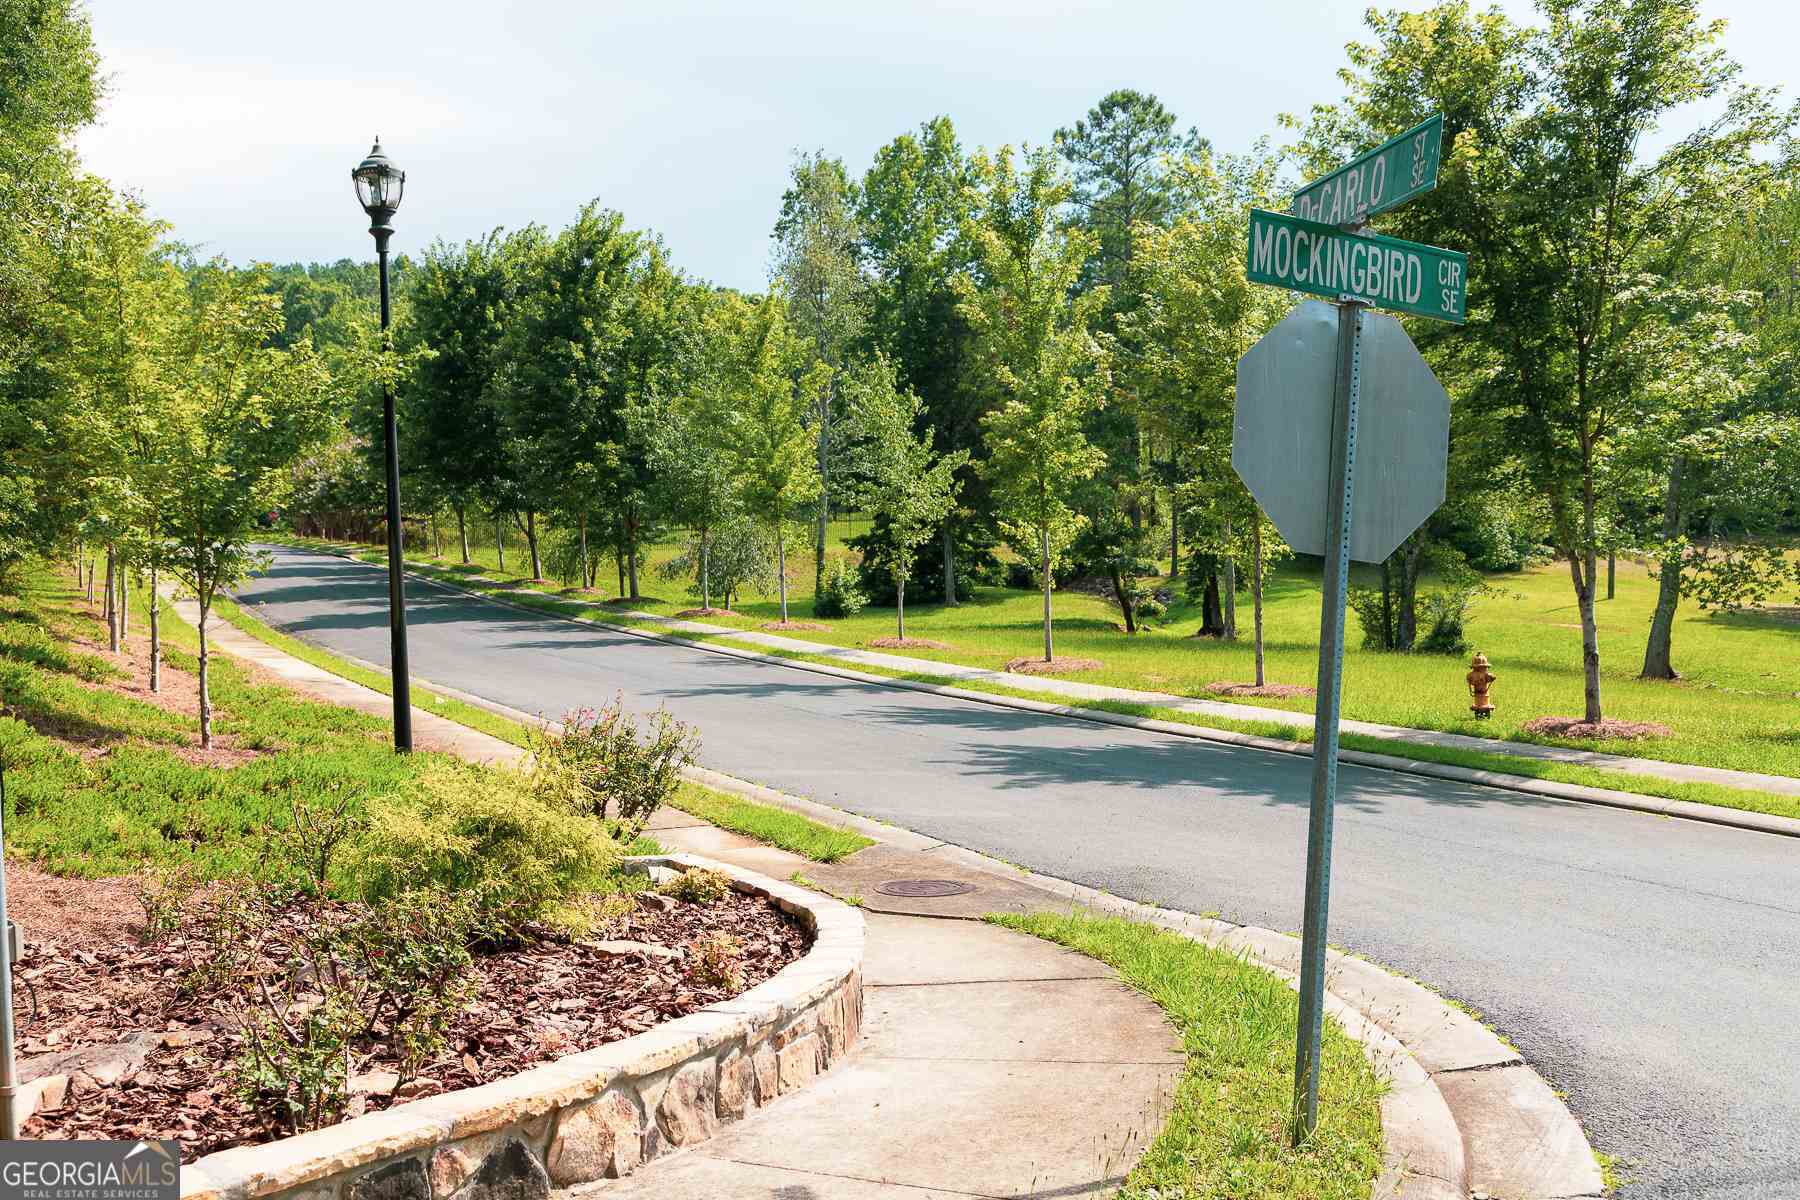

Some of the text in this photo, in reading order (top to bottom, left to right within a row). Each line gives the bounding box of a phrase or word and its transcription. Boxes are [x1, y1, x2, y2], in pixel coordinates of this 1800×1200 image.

[1412, 131, 1429, 160] ST
[1410, 161, 1426, 188] SE
[1252, 221, 1422, 305] MOCKINGBIRD
[1438, 258, 1461, 289] CIR
[1440, 289, 1459, 314] SE
